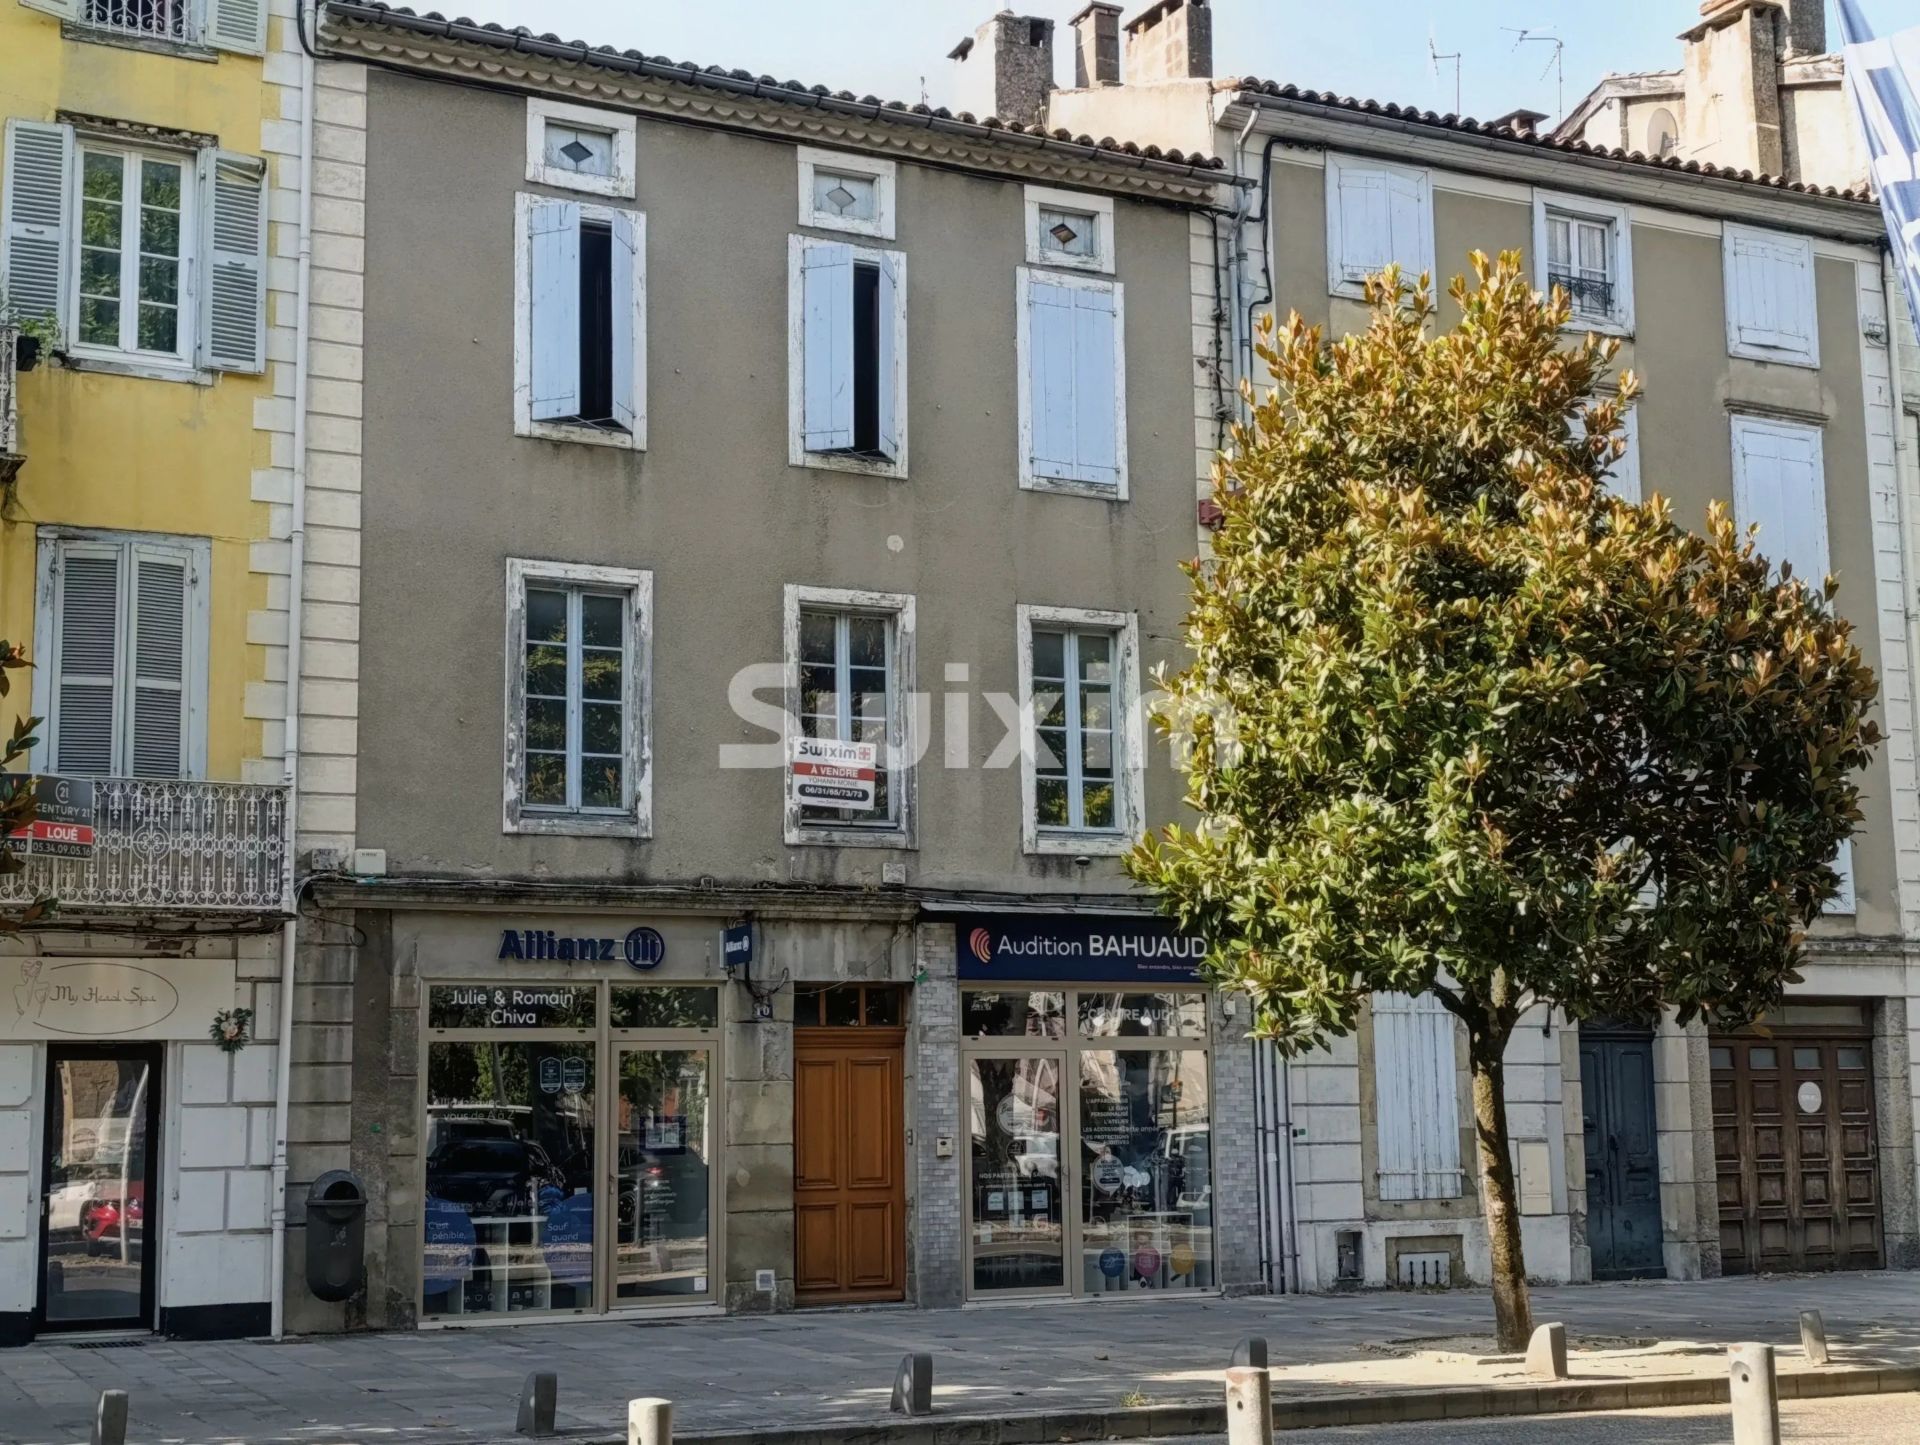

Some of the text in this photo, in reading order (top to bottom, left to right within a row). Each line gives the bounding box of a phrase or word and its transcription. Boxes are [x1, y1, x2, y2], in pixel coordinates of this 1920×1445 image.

[799, 741, 857, 760] Swixim
[810, 764, 859, 778] À VENDRE
[35, 802, 91, 818] CENTURY 21
[46, 826, 79, 841] LOUÉ
[32, 841, 91, 857] 05.34.09.05.16
[497, 929, 617, 961] Allianz
[725, 941, 743, 953] Allianz
[997, 934, 1207, 958] Audition BAHUAUD
[49, 985, 79, 1006] My
[451, 990, 574, 1006] Julie & Romain
[490, 1009, 537, 1025] Chiva
[547, 1222, 568, 1232] Sauf
[551, 1232, 579, 1242] quand
